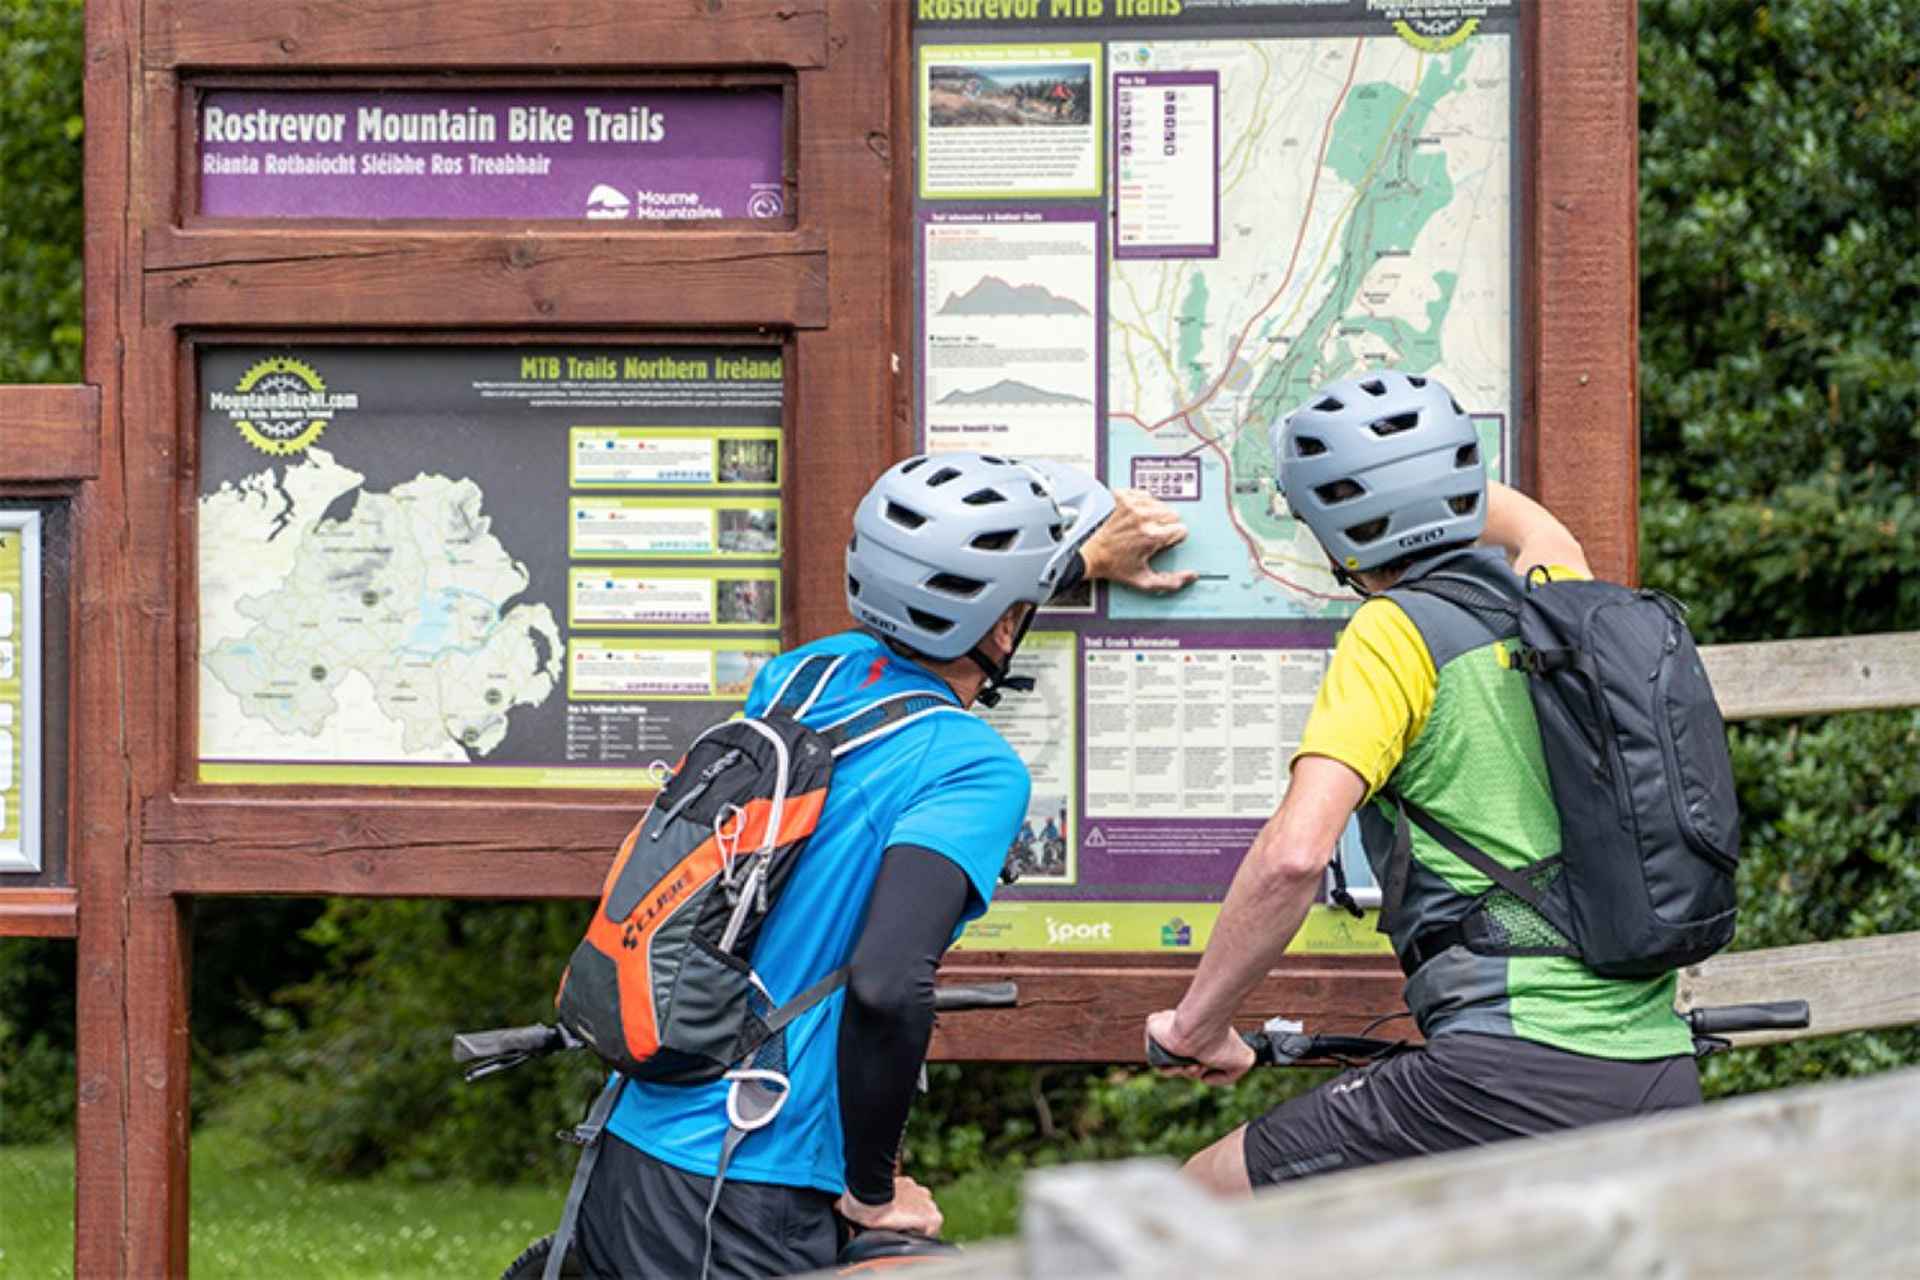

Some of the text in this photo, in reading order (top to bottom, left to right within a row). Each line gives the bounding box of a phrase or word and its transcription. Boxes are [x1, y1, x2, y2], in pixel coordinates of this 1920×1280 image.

[918, 0, 1039, 20] Rostrevor
[204, 106, 665, 142] Rostrevor Mountain Bike Trails
[203, 153, 259, 175] Rianta
[431, 153, 463, 175] Ros
[469, 153, 552, 175] Treabhair
[638, 191, 699, 205] Mourne
[638, 205, 723, 219] Mountains
[520, 357, 783, 379] MTB Trails Northern Ireland
[210, 391, 358, 410] MountainBikeNI.com
